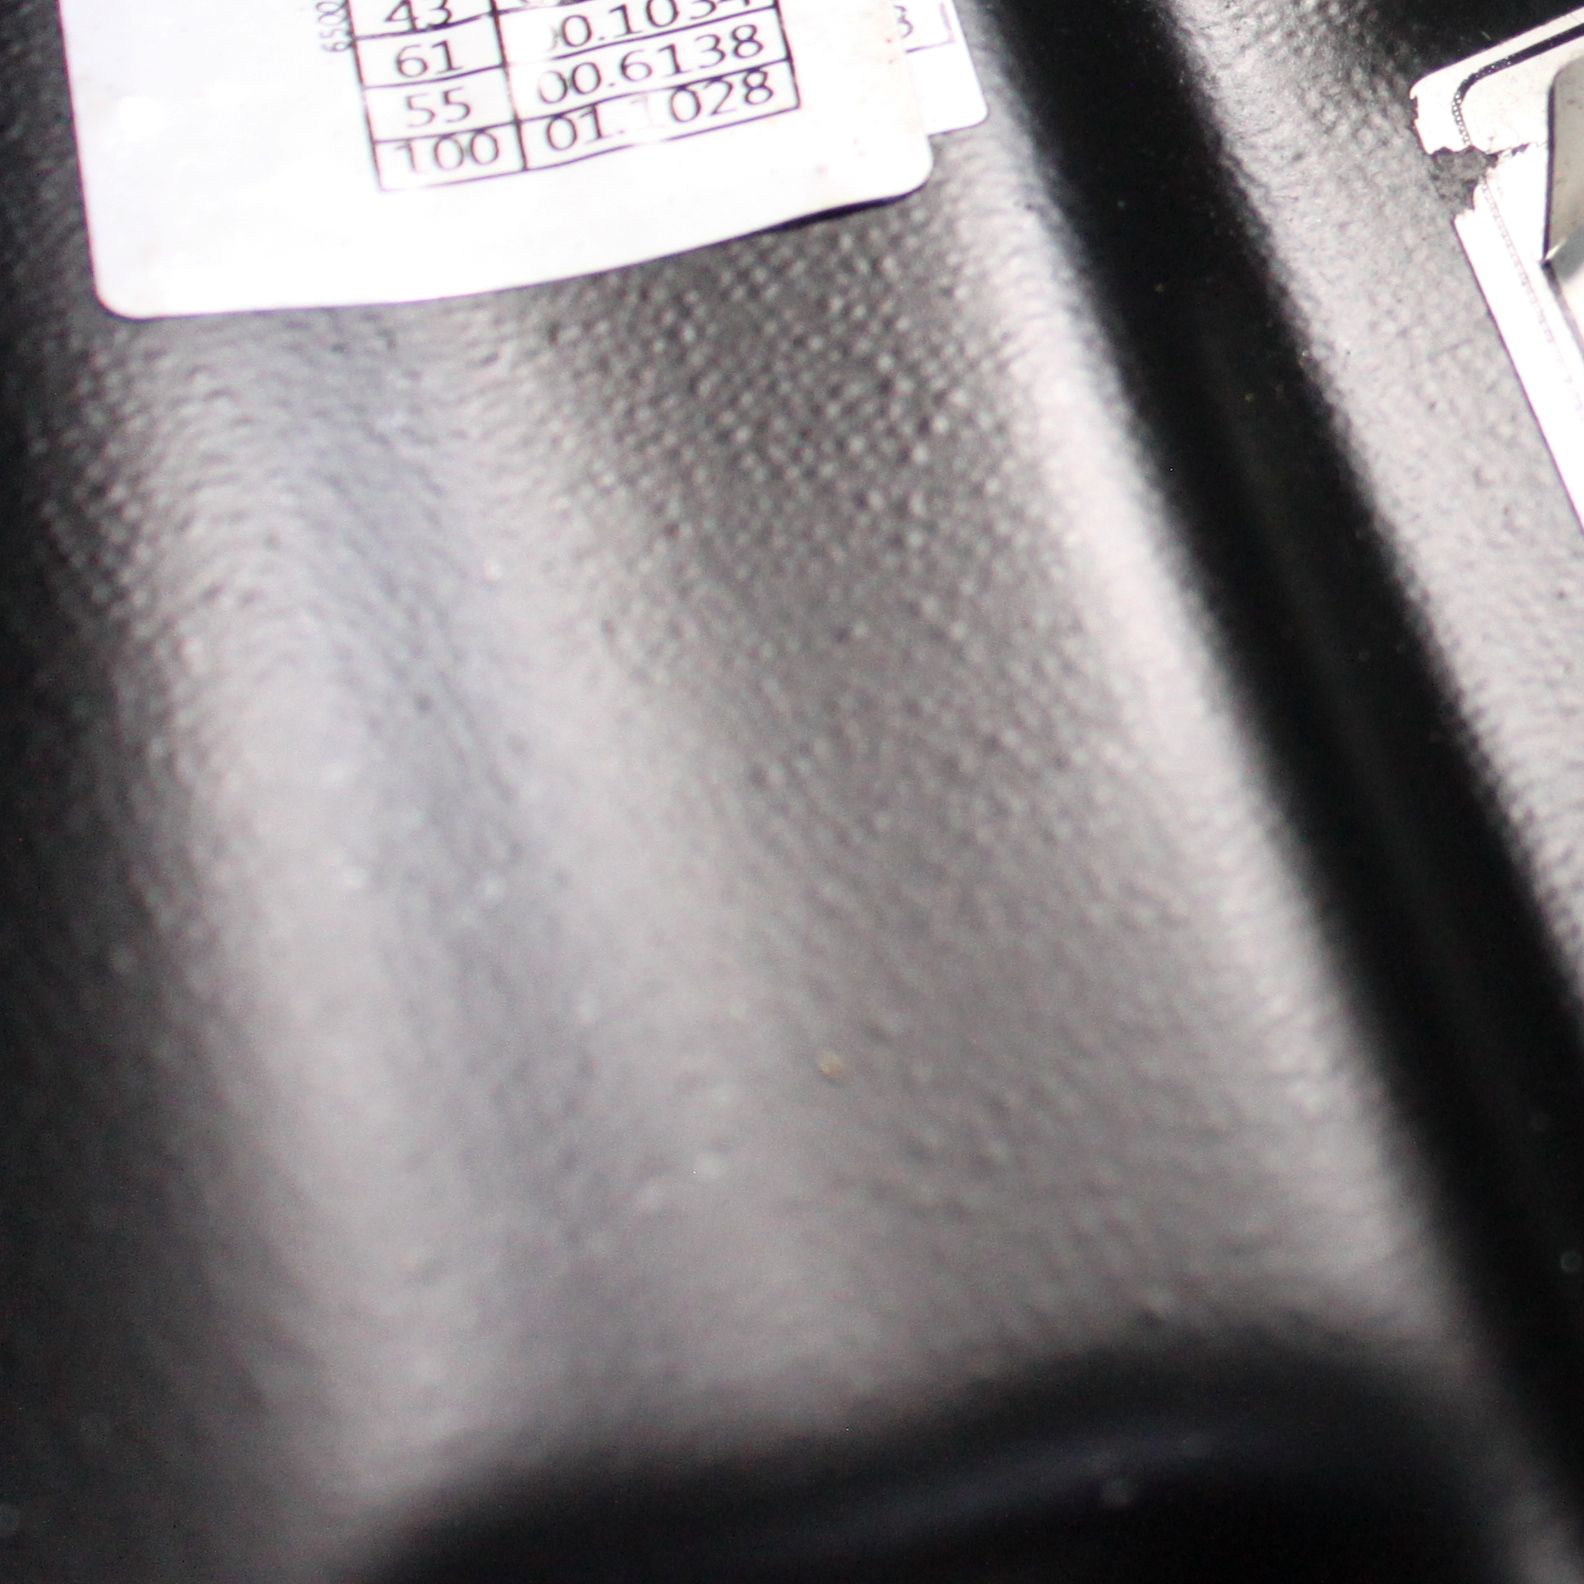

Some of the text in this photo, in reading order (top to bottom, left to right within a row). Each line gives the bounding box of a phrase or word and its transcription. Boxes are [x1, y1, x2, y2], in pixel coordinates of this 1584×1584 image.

[394, 38, 465, 79] 61
[405, 22, 765, 129] 55 00.6138
[396, 129, 501, 174] 100
